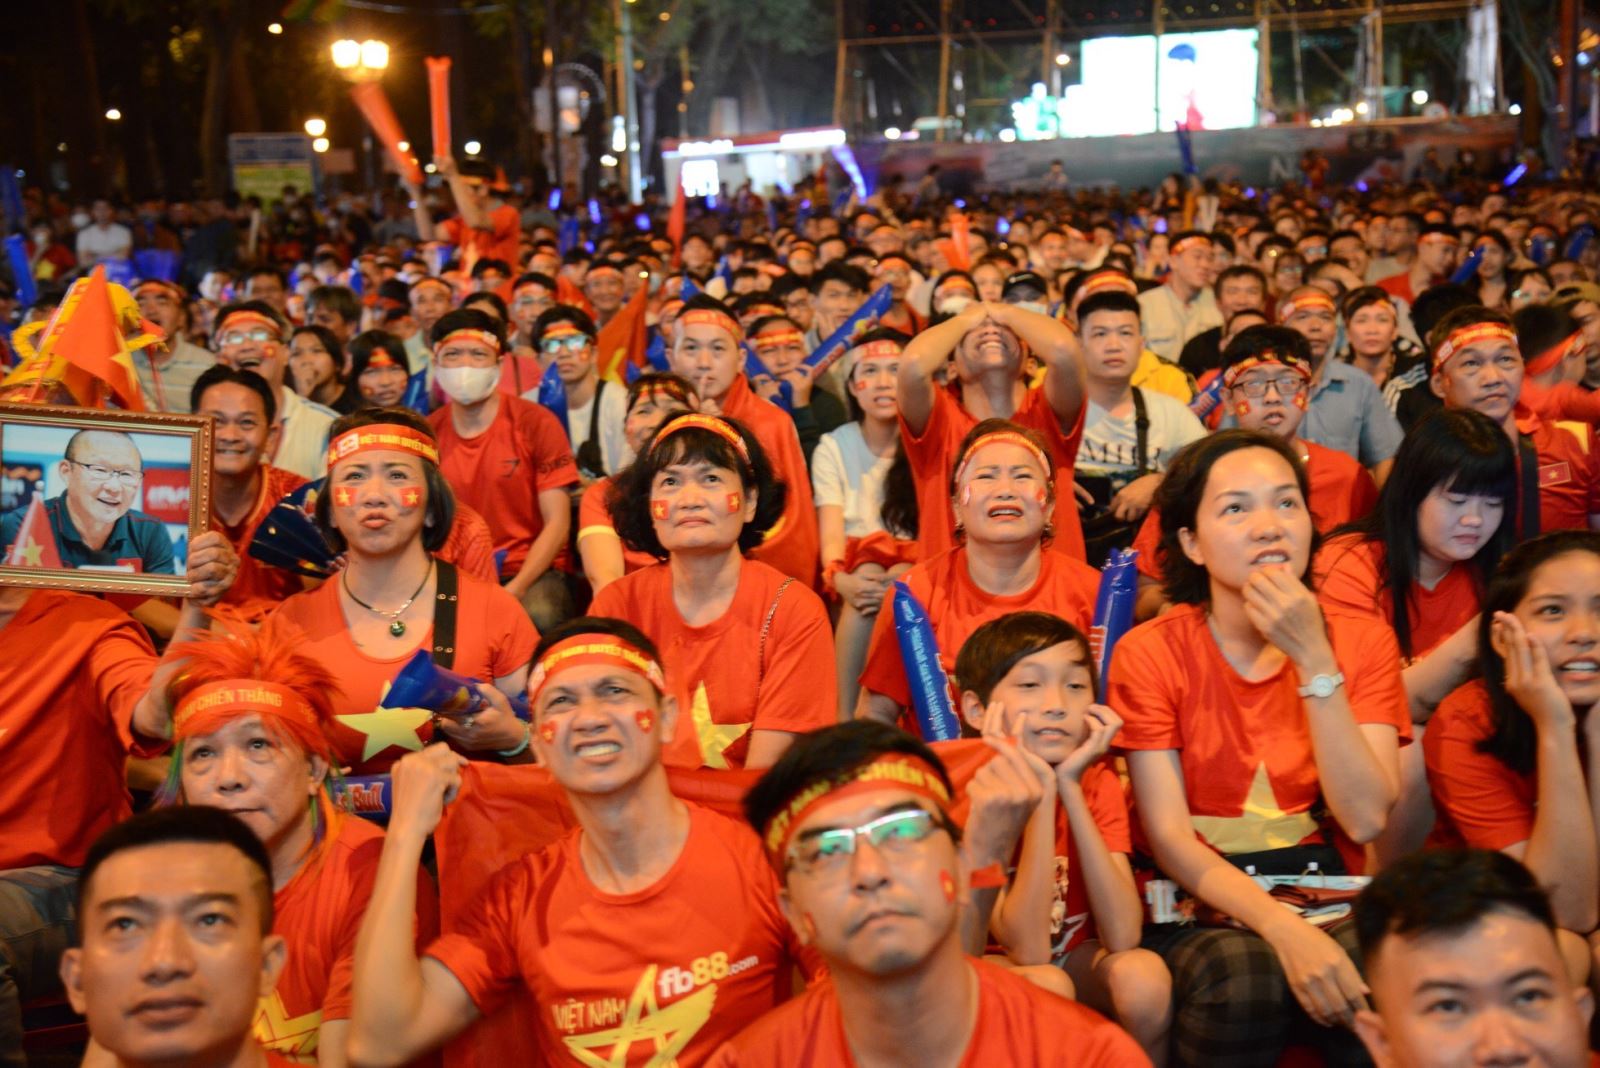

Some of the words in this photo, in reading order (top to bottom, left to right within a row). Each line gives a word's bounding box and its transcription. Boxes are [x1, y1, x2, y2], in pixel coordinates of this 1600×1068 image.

[196, 686, 234, 711] CHIẾN
[236, 686, 283, 708] THẮNG
[552, 998, 584, 1035] VIỆT
[588, 997, 627, 1028] NAM
